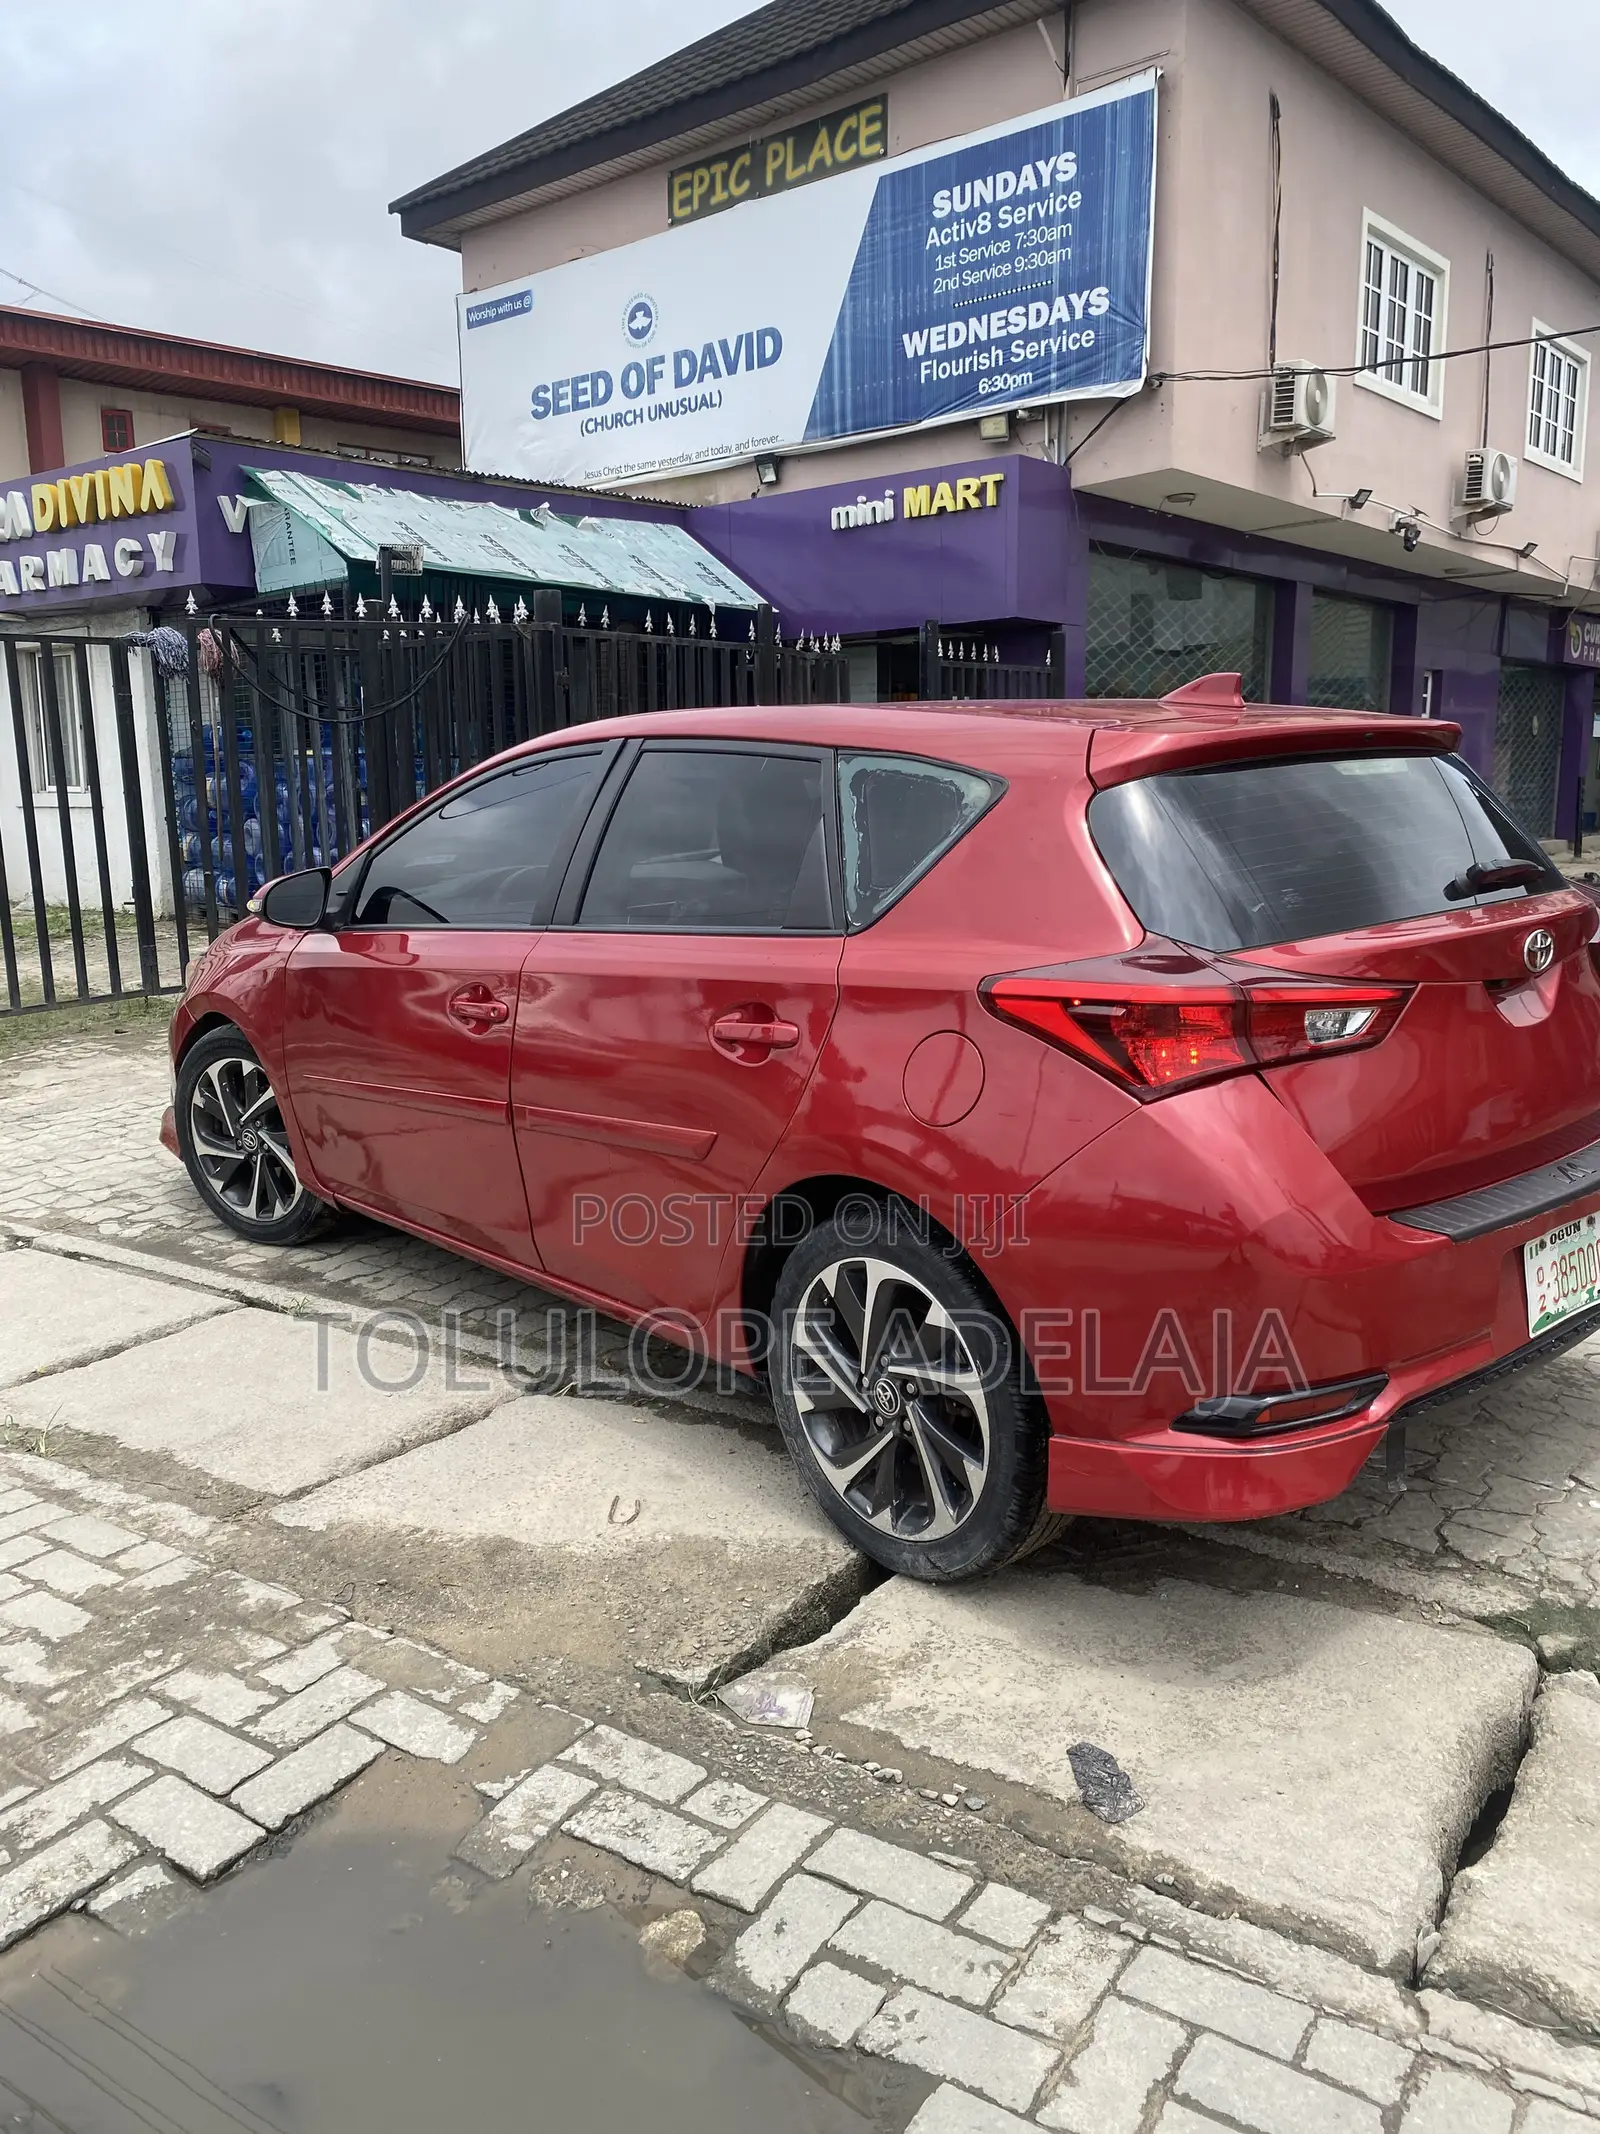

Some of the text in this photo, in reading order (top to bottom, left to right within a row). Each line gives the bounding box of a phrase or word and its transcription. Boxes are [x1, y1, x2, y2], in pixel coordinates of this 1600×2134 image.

[672, 104, 884, 217] EPIC PLACE
[932, 151, 1078, 218] SUNDAYS
[926, 190, 1082, 249] Activ8 Service
[933, 247, 1071, 294] 2nd Service 9:30am
[934, 223, 1072, 271] 1st Service 7:30am
[468, 307, 497, 323] Worship
[497, 300, 513, 314] with
[513, 299, 522, 309] us
[902, 286, 1110, 359] WEDNESDAYS
[530, 326, 784, 421] SEED OF DAVID
[920, 329, 1095, 384] Flourish Service
[978, 371, 1033, 395] 6:30pm
[580, 389, 723, 438] (CHURCH UNUSUAL)
[584, 470, 602, 480] Jesus
[603, 465, 623, 476] Christ
[624, 463, 636, 472] the
[637, 459, 657, 471] same
[657, 452, 694, 469] yesterday,
[695, 447, 709, 460] and
[711, 443, 734, 457] today,
[735, 439, 750, 452] and
[831, 473, 1004, 531] mini MART
[1549, 1219, 1581, 1245] OGUN
